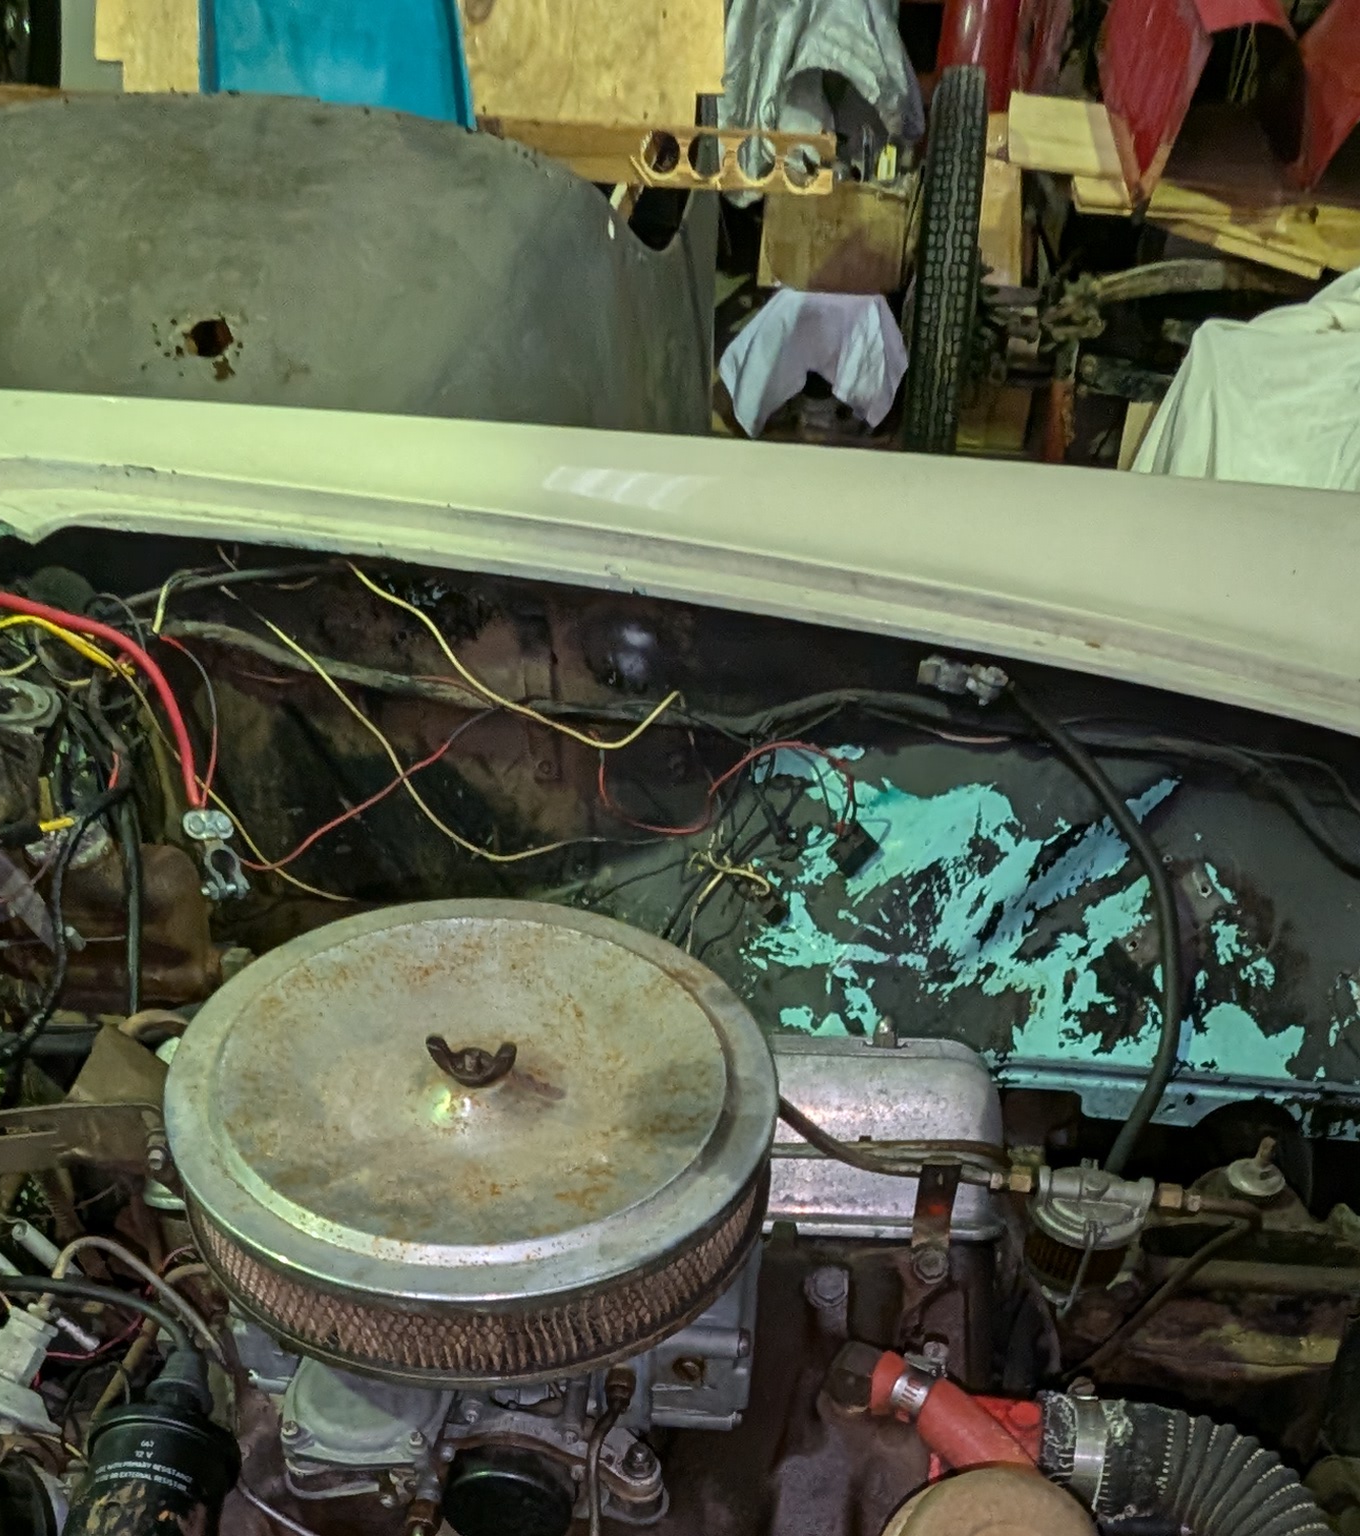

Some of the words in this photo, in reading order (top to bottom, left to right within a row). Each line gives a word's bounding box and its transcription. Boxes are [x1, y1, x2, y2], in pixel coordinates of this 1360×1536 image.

[134, 1450, 145, 1459] 12
[146, 1451, 154, 1459] V
[109, 1471, 120, 1480] OR
[119, 1471, 152, 1481] EXTERNAL
[122, 1460, 152, 1469] PRIMARY
[152, 1463, 193, 1484] RESISTANCE
